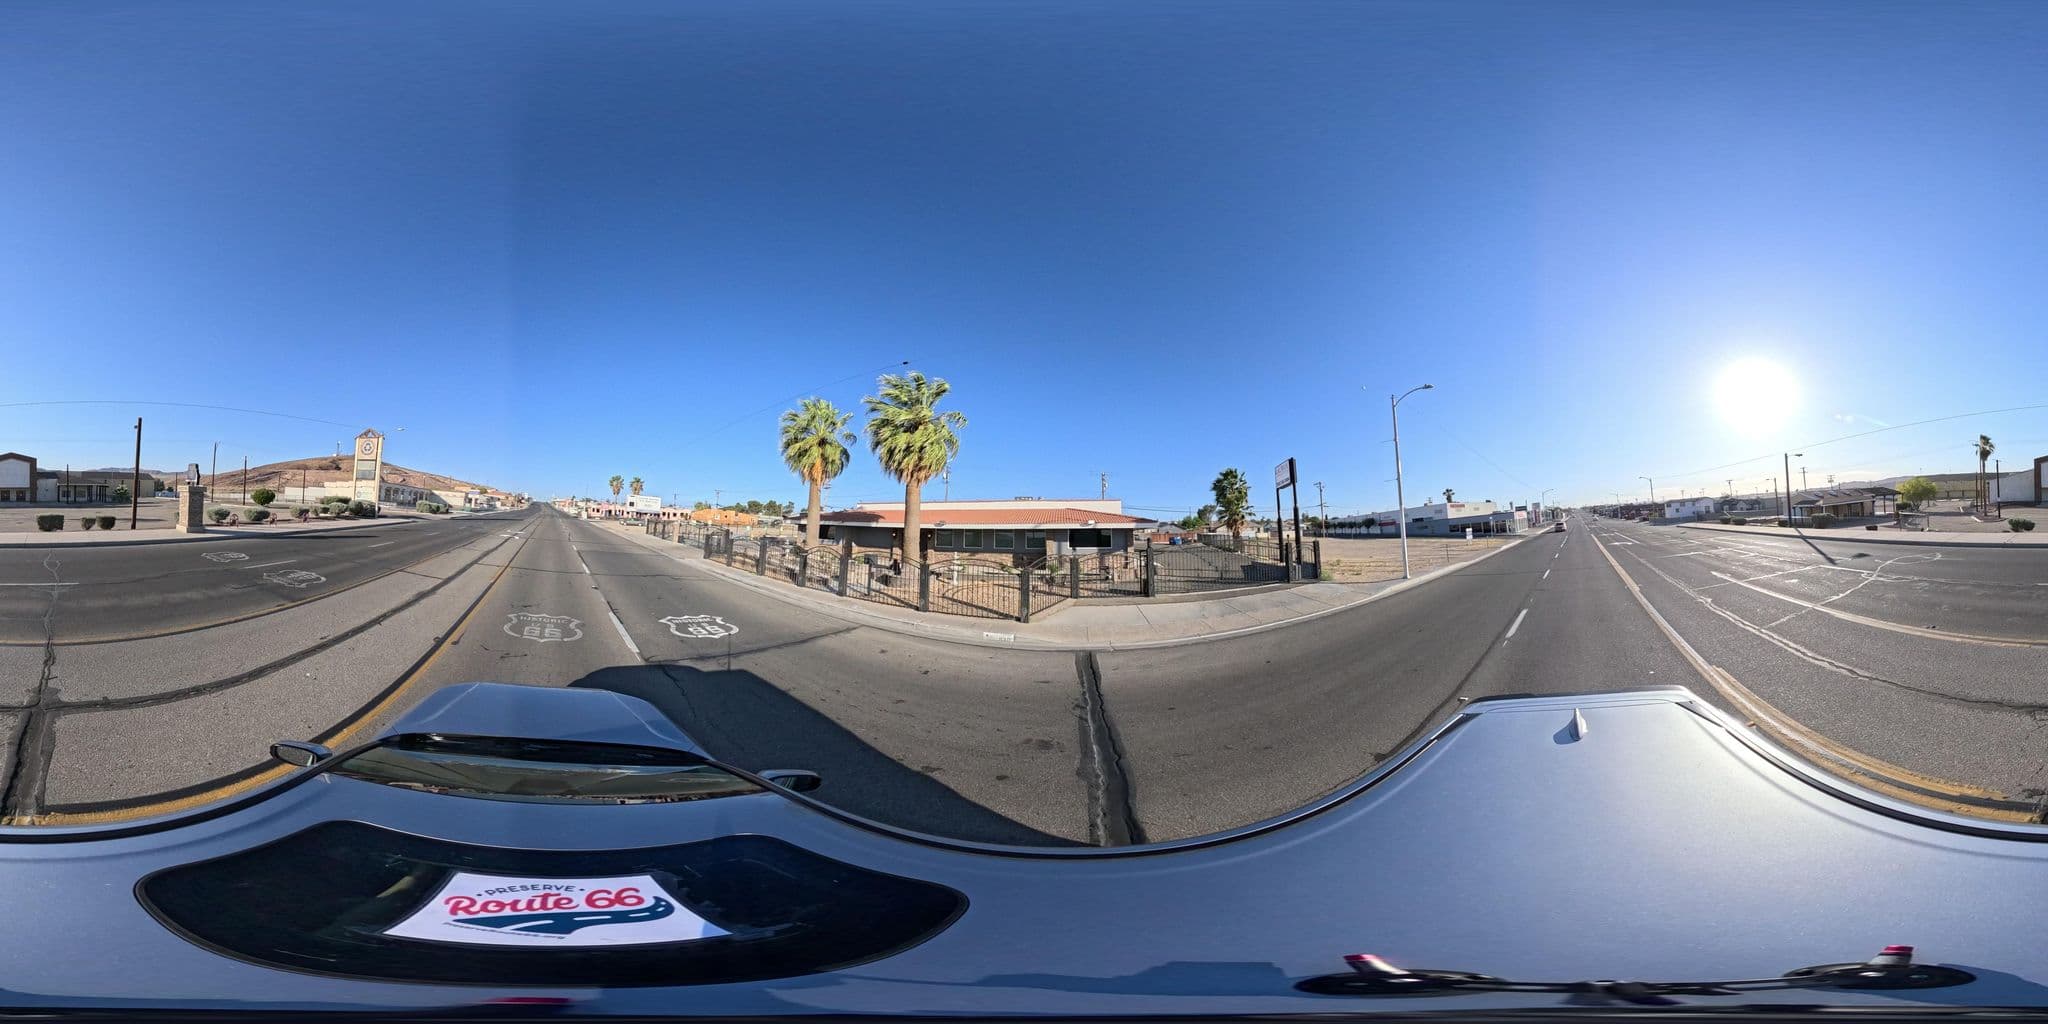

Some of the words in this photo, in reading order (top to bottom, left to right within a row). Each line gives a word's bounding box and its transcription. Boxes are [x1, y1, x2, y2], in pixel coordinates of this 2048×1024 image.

[485, 884, 576, 896] PRESERVE
[444, 892, 580, 916] Route
[584, 887, 645, 910] 66
